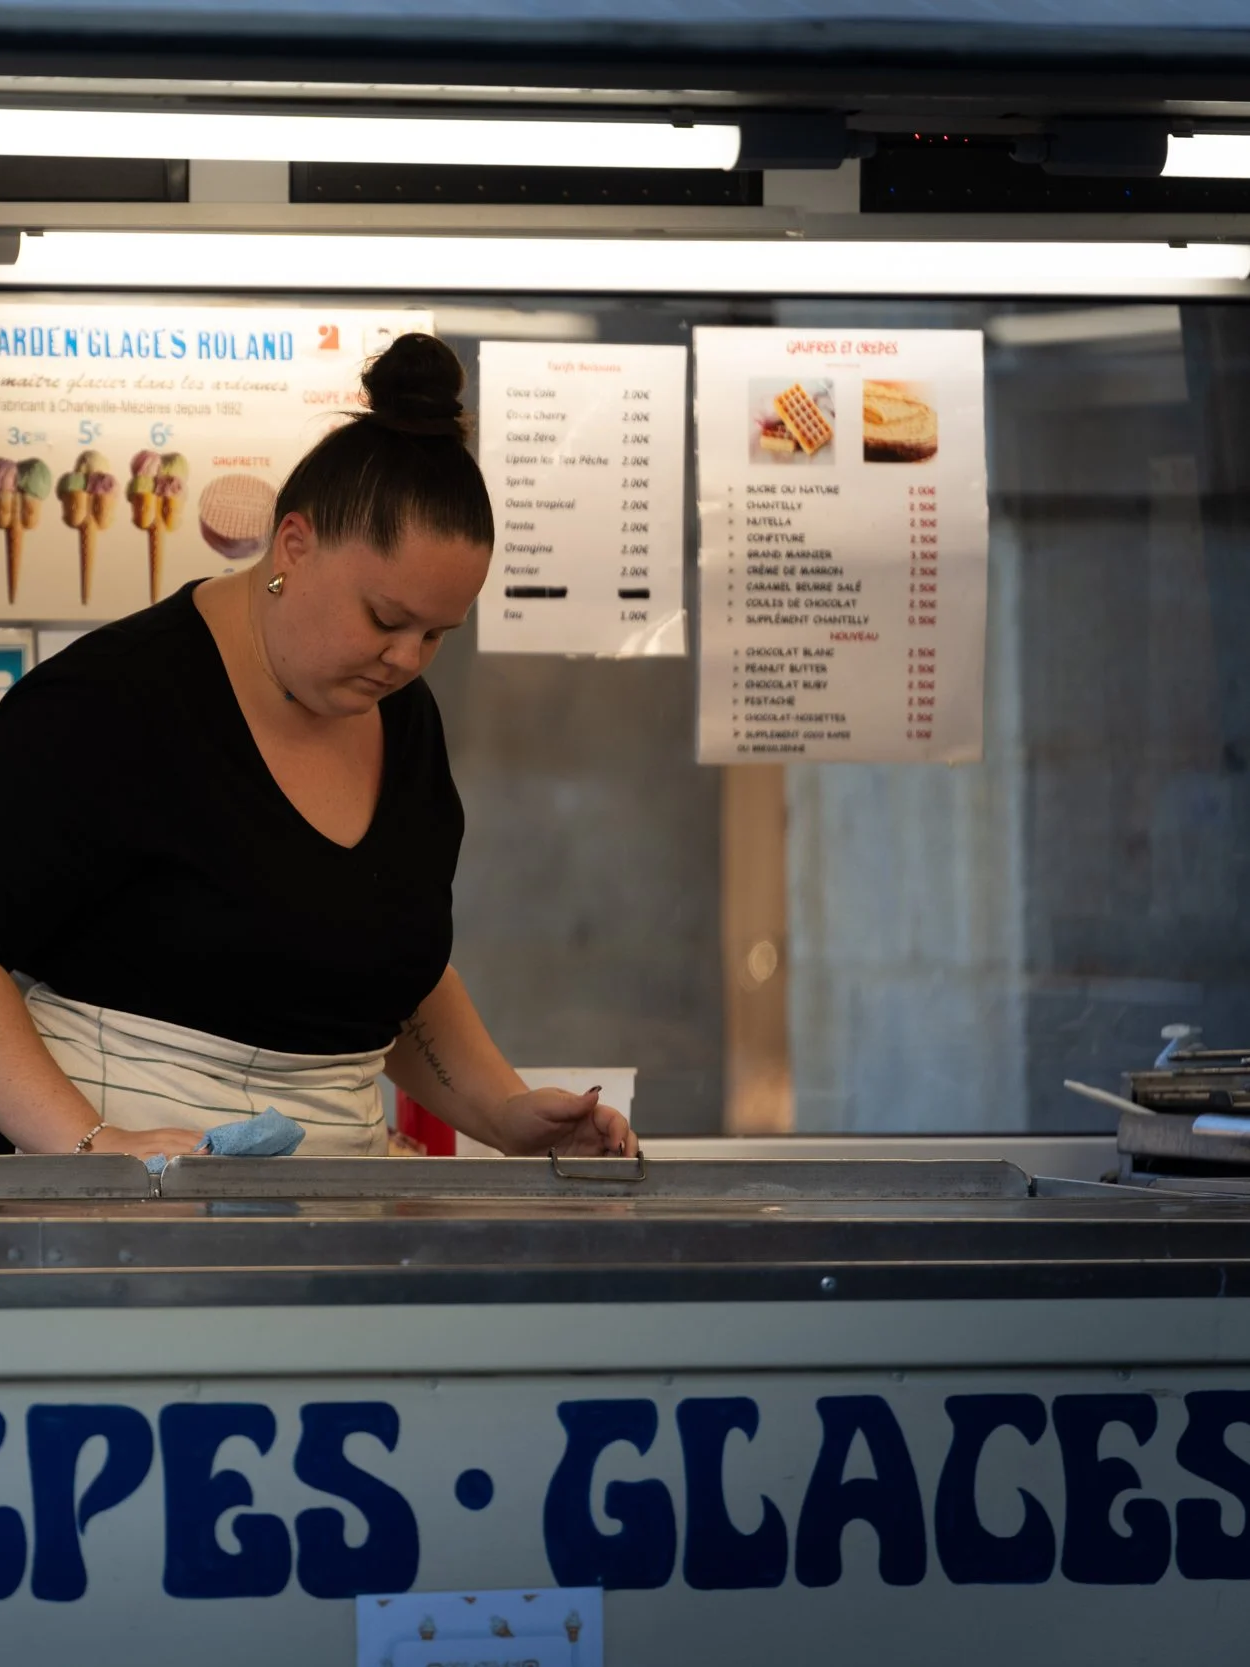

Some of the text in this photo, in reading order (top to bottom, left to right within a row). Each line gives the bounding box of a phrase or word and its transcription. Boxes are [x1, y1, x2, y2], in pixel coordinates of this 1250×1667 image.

[197, 330, 293, 361] ROLAND
[746, 517, 791, 527] NUTELLA
[804, 598, 857, 609] CHOCOLAT
[830, 631, 879, 641] NOUVEAU
[543, 1390, 1250, 1591] GLACES
